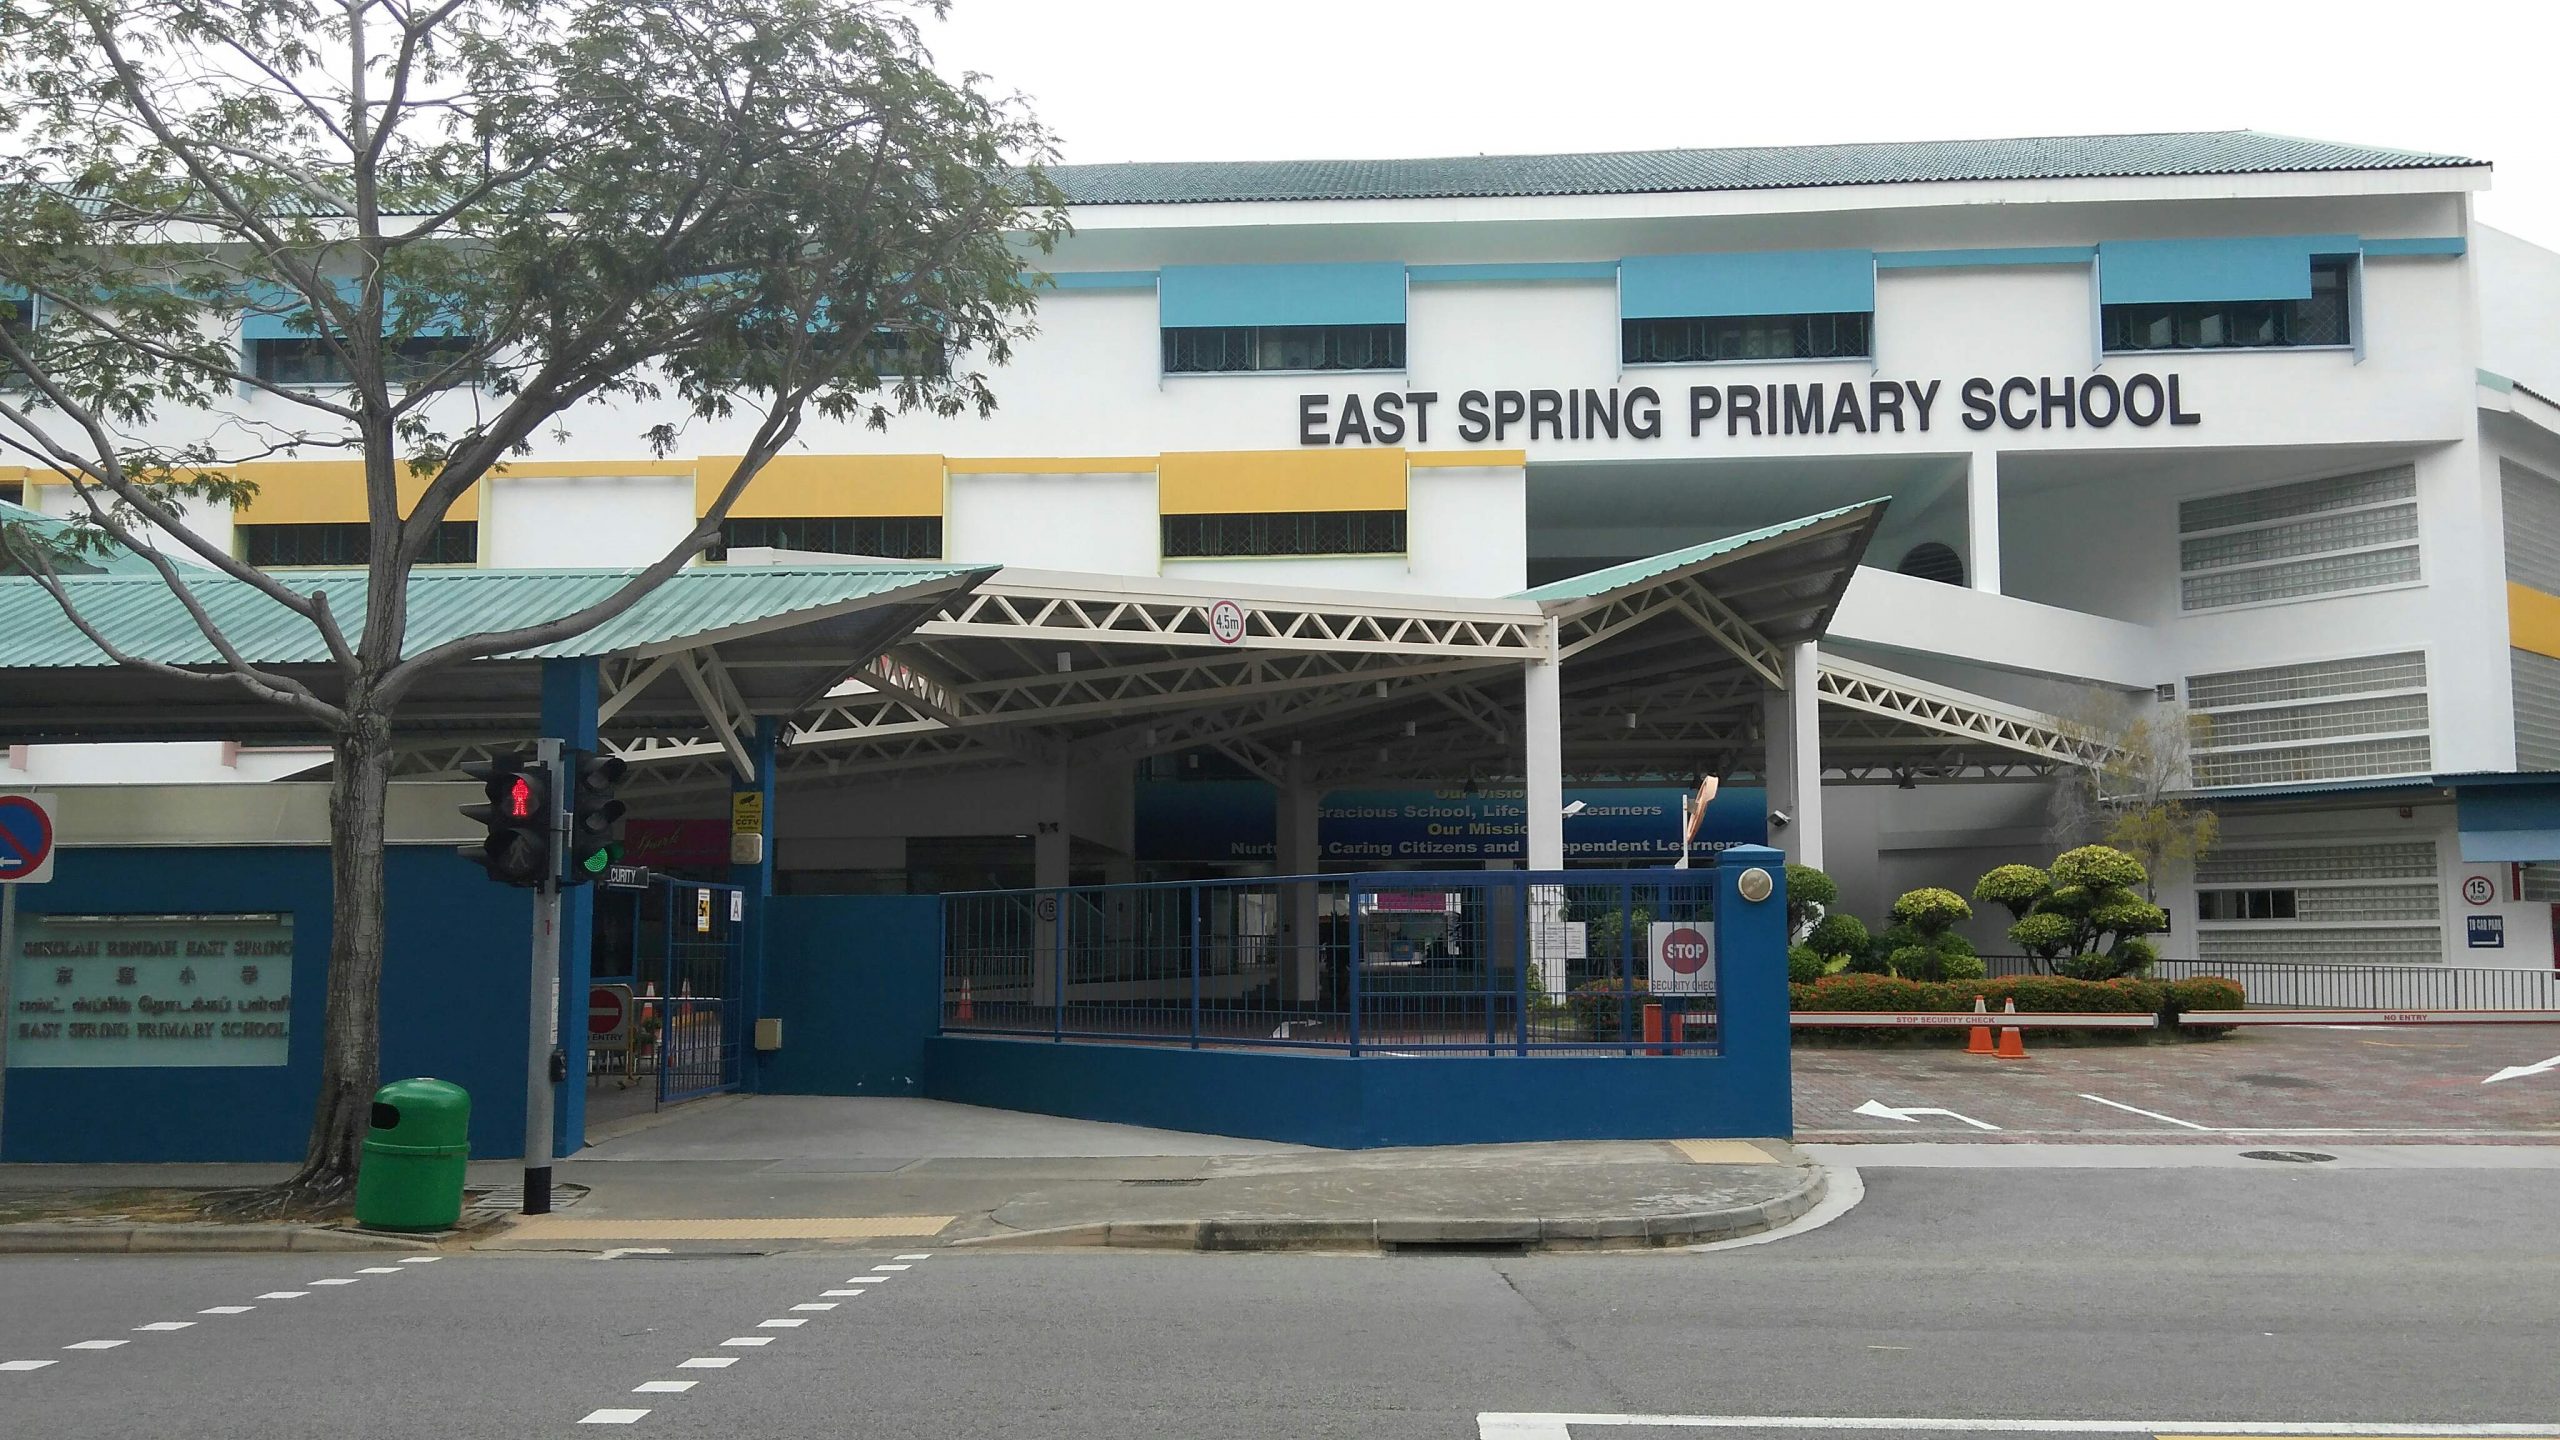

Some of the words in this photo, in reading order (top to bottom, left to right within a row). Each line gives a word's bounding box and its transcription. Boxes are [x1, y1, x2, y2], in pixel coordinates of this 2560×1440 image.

[1300, 391, 1438, 445] EAST
[1458, 386, 1662, 443] SPRING
[1690, 379, 1942, 437] PRIMARY
[1961, 373, 2201, 431] SCHOOL
[1216, 614, 1239, 630] 4.5m
[1436, 789, 1467, 799] Our
[1478, 789, 1527, 799] Visio
[1404, 805, 1477, 820] School,
[1428, 823, 1463, 835] Our
[1469, 823, 1529, 835] Missio
[1328, 841, 1393, 857] Caring
[1399, 841, 1478, 854] Citizens
[1484, 841, 1520, 853] and
[604, 868, 636, 884] CURITY
[2470, 881, 2486, 894] 15
[1667, 944, 1704, 958] STOP
[1691, 981, 1716, 991] CHEC
[1921, 1016, 1962, 1024] SECURITY
[1965, 1016, 1995, 1024] CHECK
[221, 1022, 288, 1039] SCHOOL
[592, 1033, 623, 1041] ENTRY
